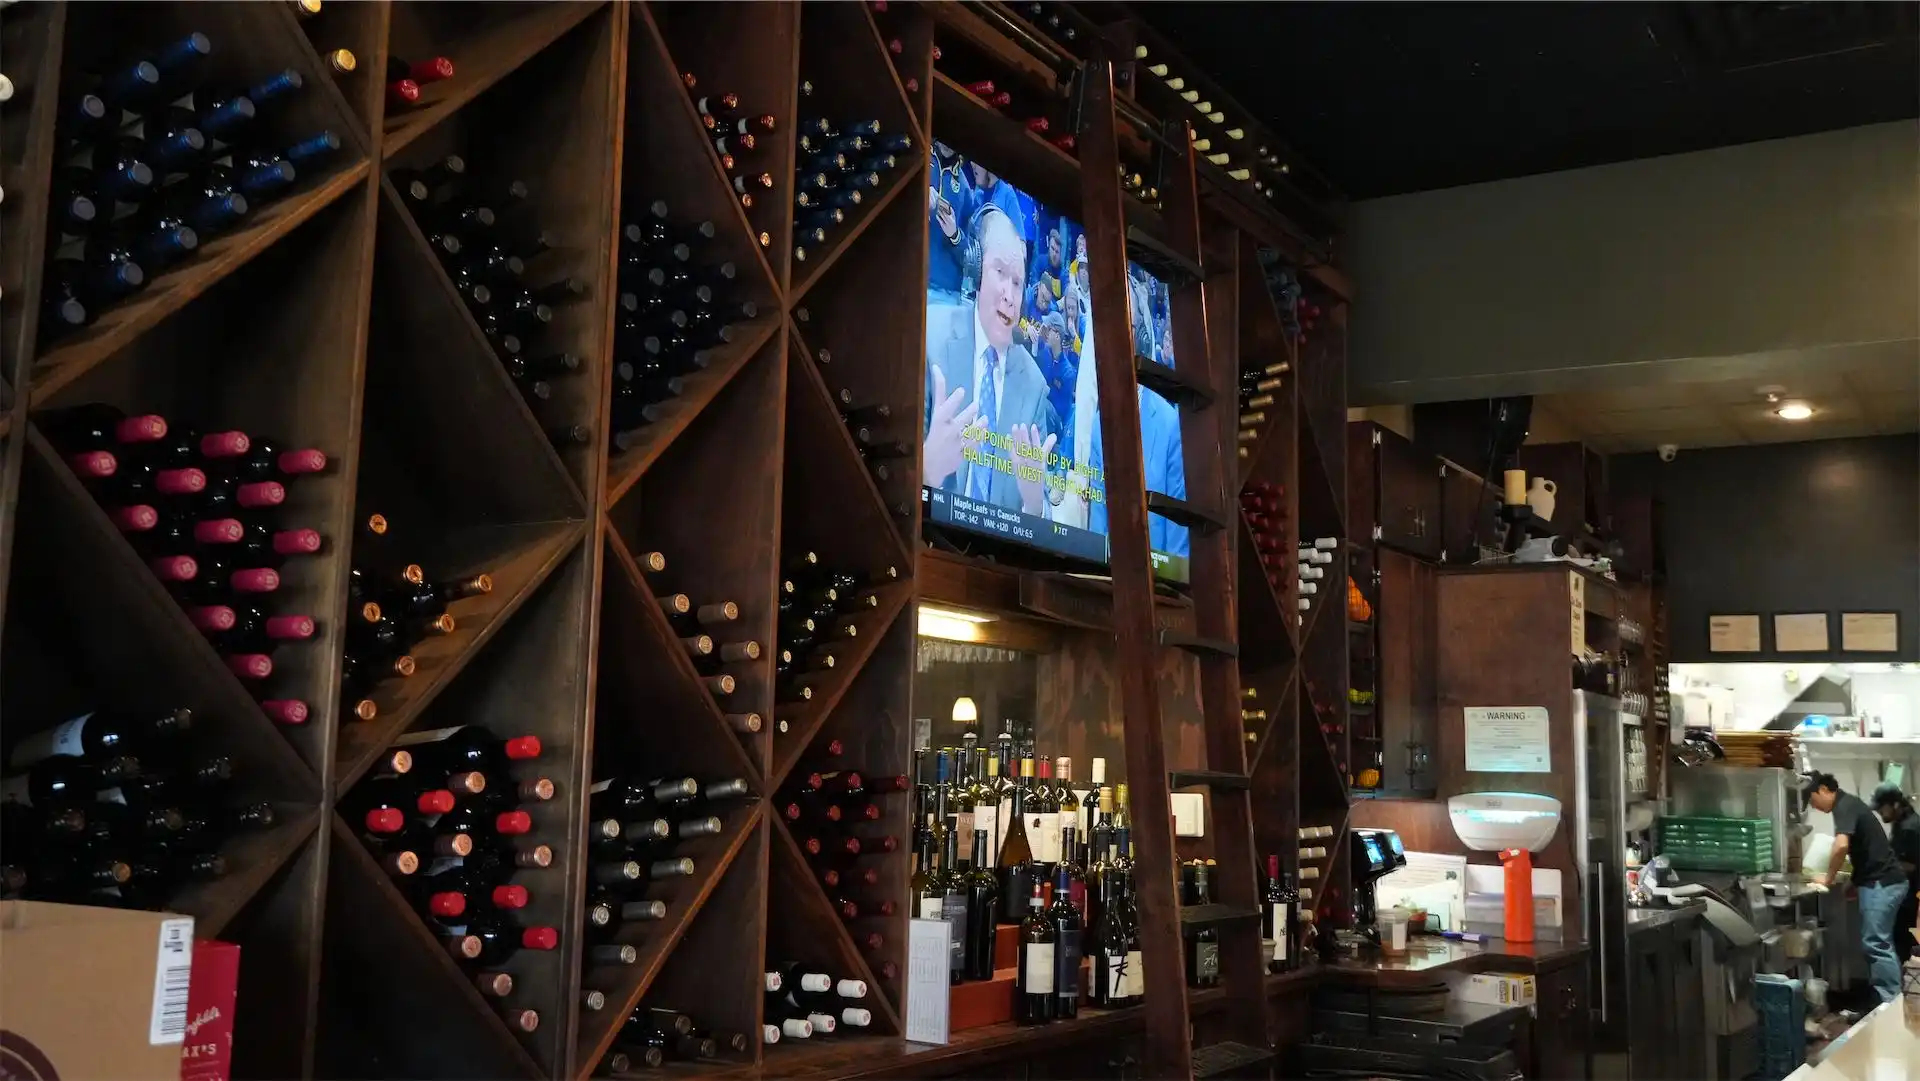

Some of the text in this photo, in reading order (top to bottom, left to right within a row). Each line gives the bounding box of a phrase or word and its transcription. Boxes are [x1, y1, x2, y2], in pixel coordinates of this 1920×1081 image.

[984, 430, 1014, 451] POINT
[1016, 441, 1043, 462] LEADS
[1046, 451, 1059, 467] UP
[1060, 456, 1072, 471] BY
[1017, 463, 1043, 484] WEST
[1083, 486, 1103, 502] HAD
[933, 492, 945, 504] NHL
[953, 496, 1021, 523] Maple Leafs vs Canucks
[953, 509, 967, 521] TOR:
[983, 517, 996, 529] VAN:
[1487, 712, 1526, 720] WARNING
[182, 1043, 216, 1058] AX'S
